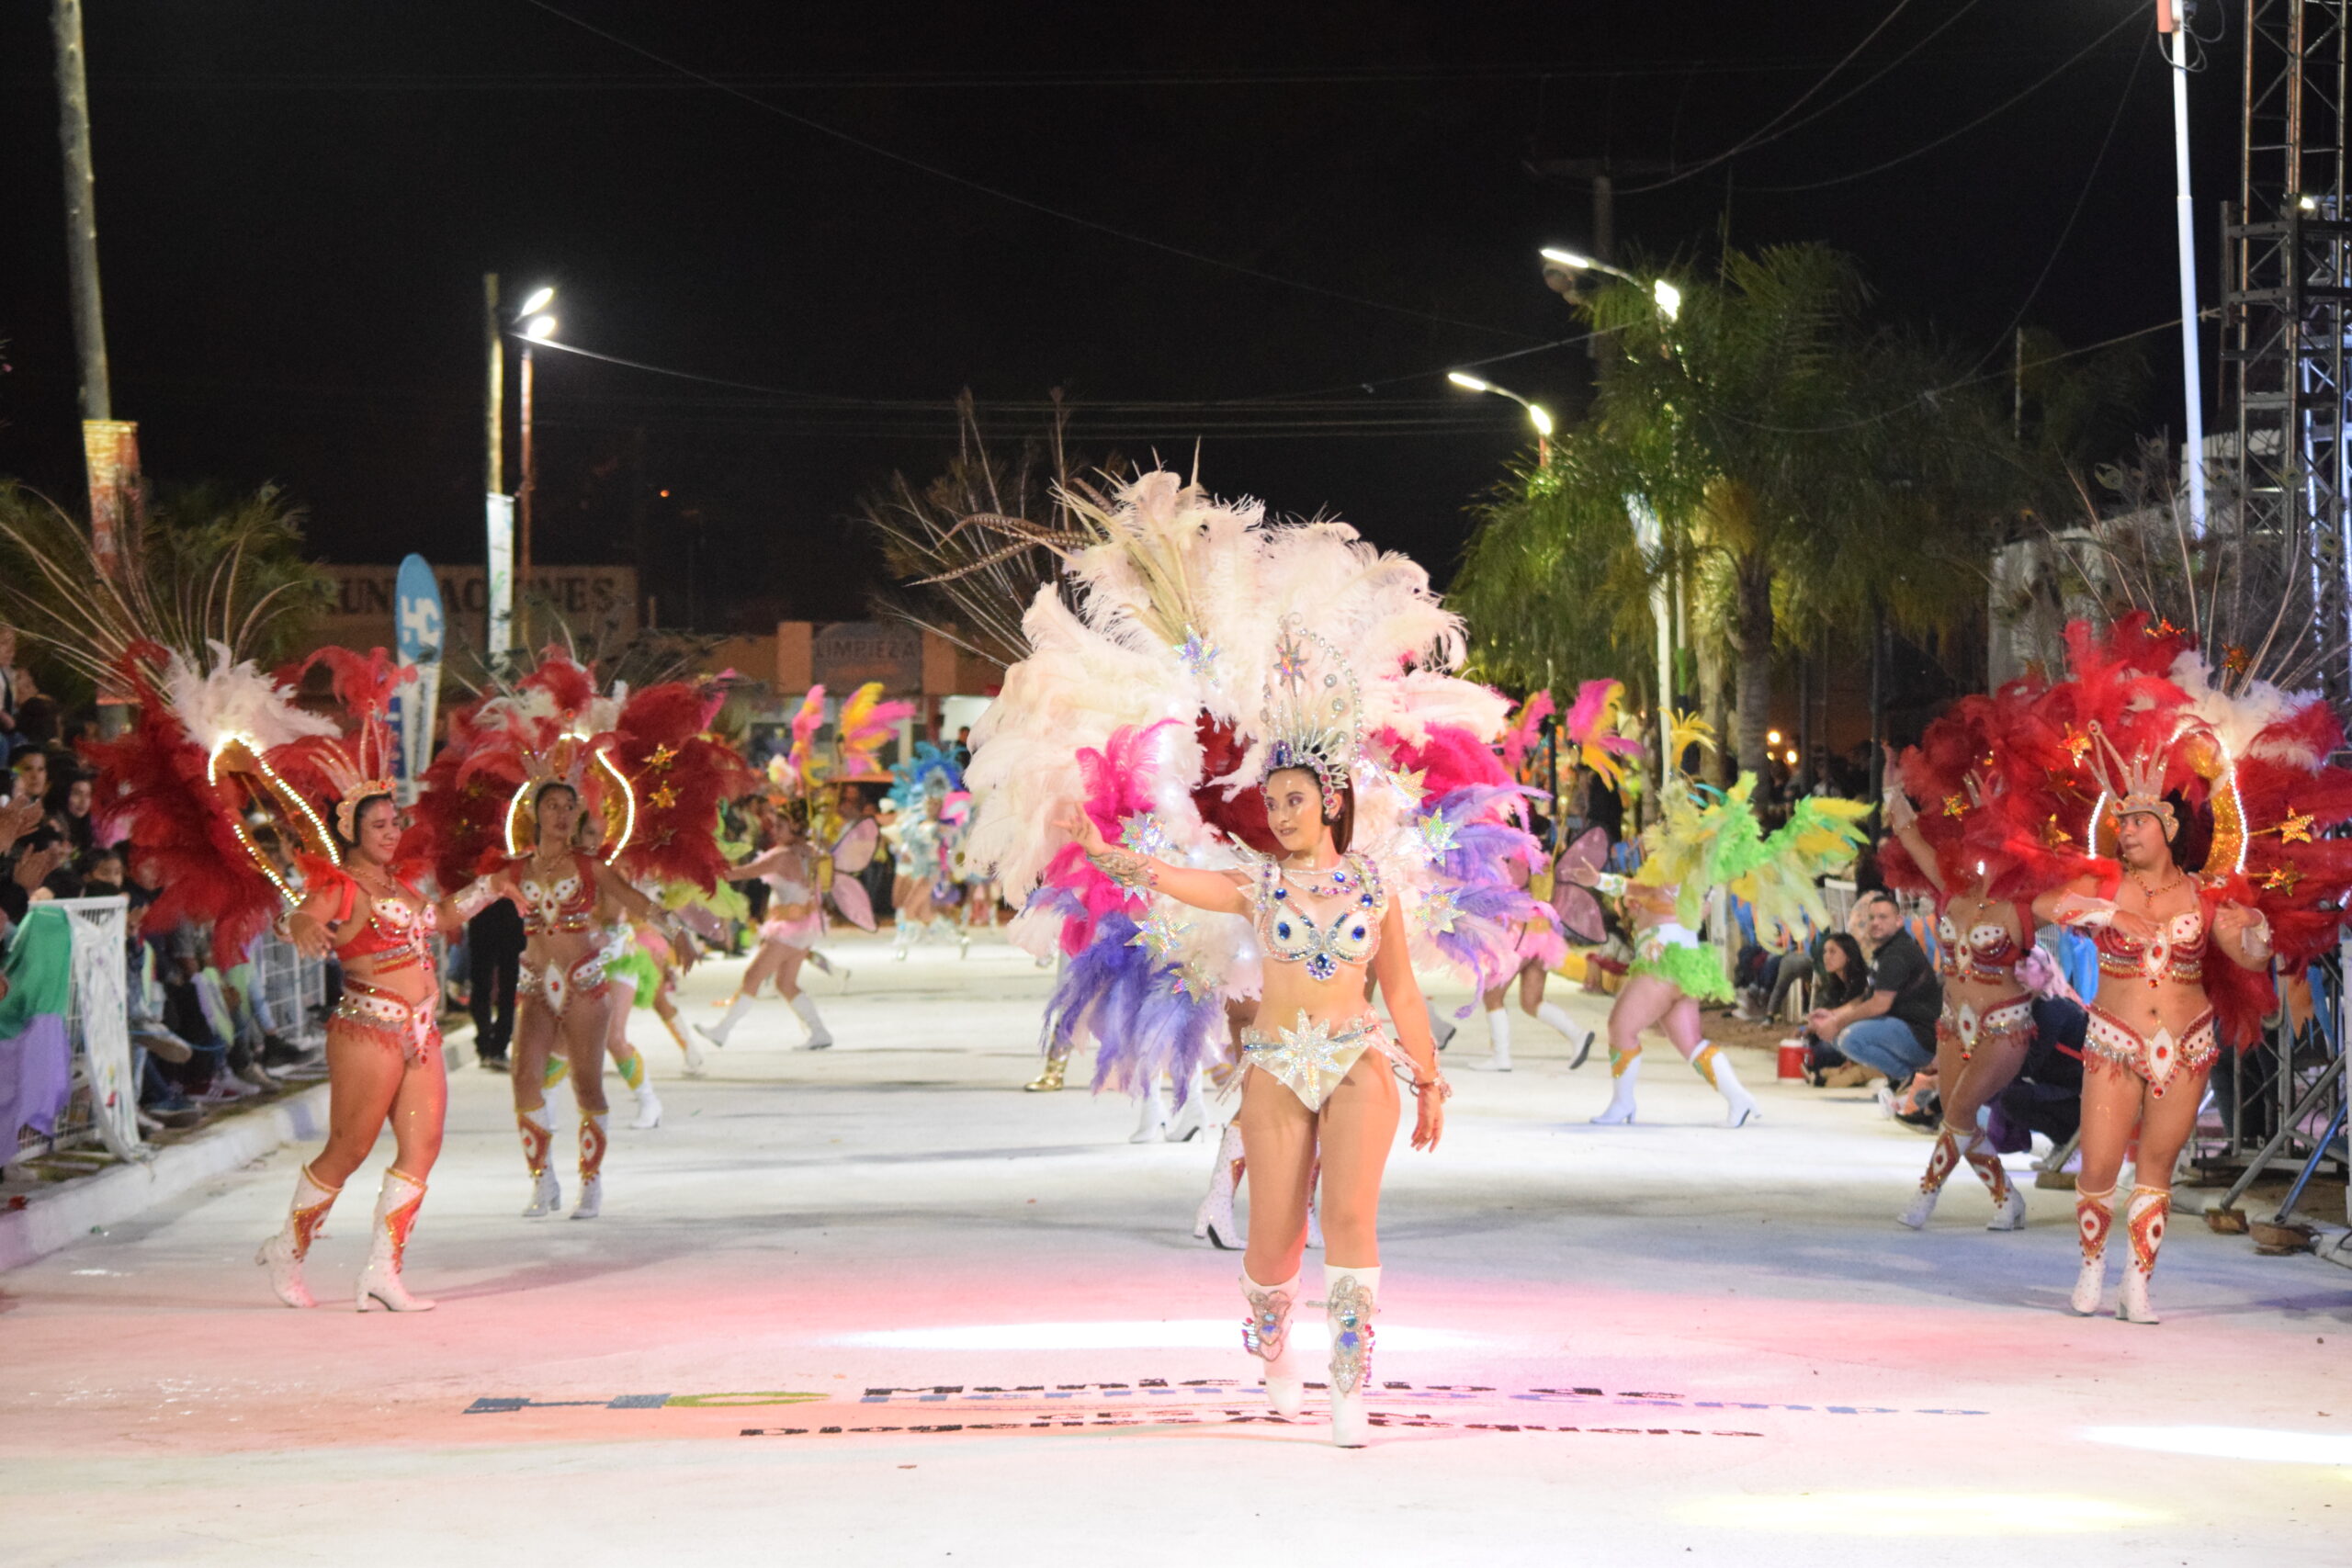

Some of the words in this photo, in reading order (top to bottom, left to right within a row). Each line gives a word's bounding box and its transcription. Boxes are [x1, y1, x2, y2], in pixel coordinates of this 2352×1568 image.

[816, 639, 915, 659] LIMPIEZA
[864, 1378, 1497, 1396] Municpio
[1530, 1387, 1685, 1399] de
[1510, 1394, 1990, 1415] Campo
[740, 1417, 1202, 1437] Diogenes
